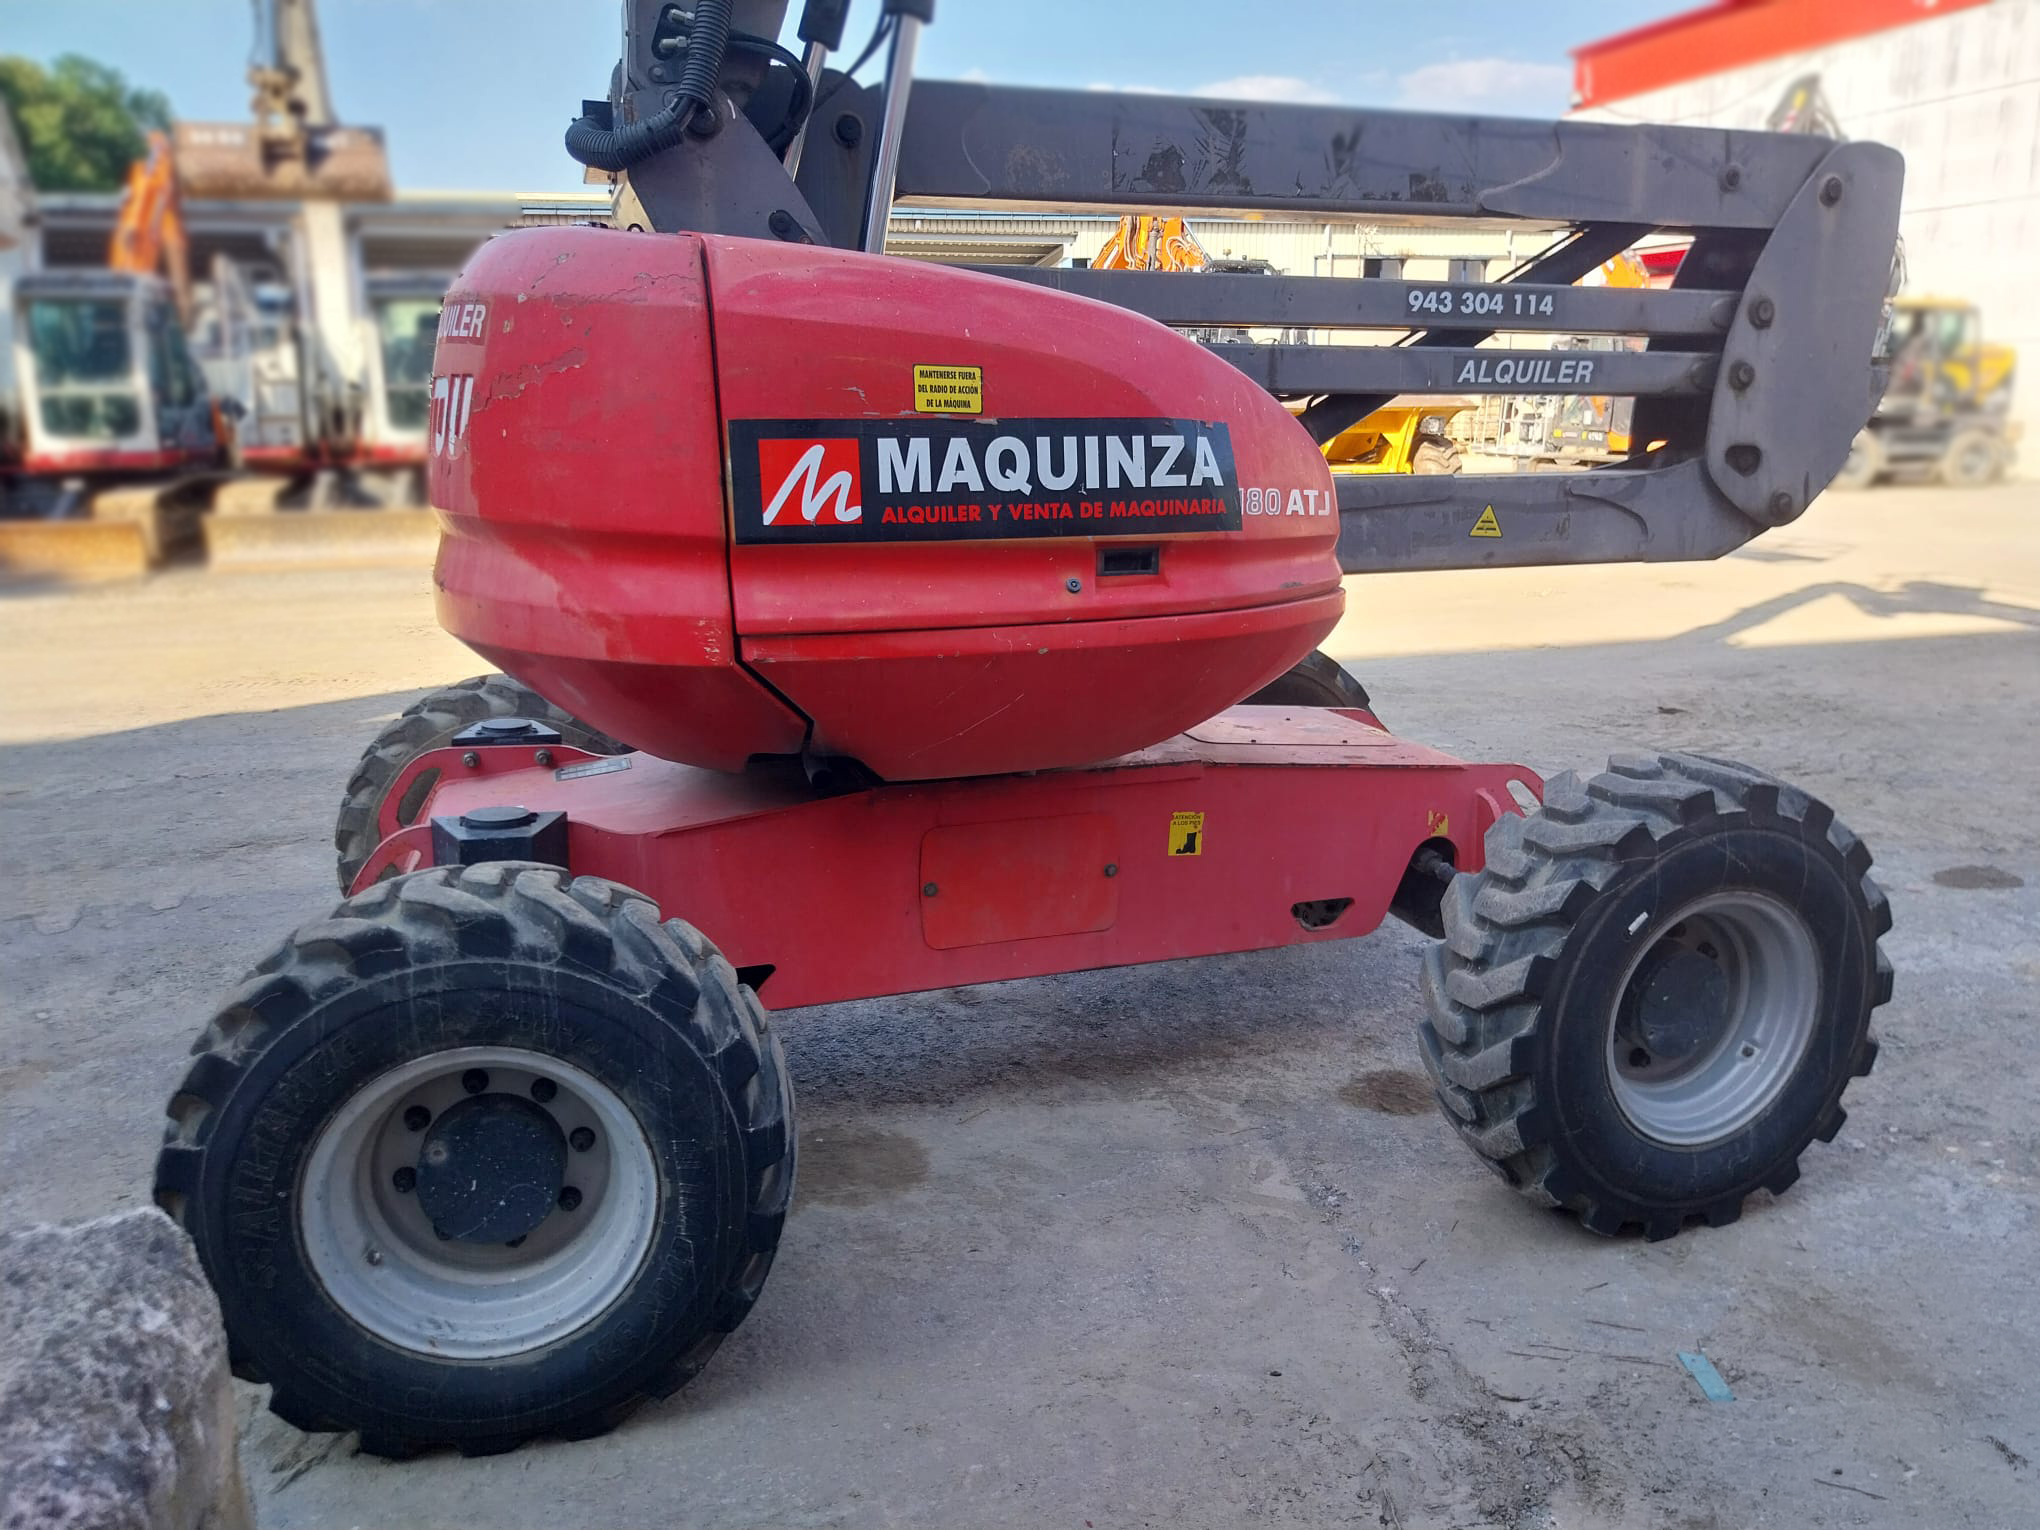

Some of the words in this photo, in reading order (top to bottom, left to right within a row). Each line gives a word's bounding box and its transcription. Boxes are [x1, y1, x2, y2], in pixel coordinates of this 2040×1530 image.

[1408, 290, 1452, 314] 943
[1460, 292, 1503, 315] 304
[1514, 294, 1553, 316] 114
[919, 369, 957, 380] MANTENERSE
[958, 371, 976, 380] FUERA
[1457, 359, 1594, 384] ALQUILER
[918, 384, 928, 393] DEL
[930, 385, 948, 394] RADIO
[949, 385, 957, 394] DE
[958, 384, 979, 395] ACCIÓN
[926, 399, 934, 408] DE
[935, 399, 942, 408] LA
[944, 397, 971, 409] MÁQUINA
[877, 435, 1224, 496] MAQUINZA
[882, 504, 981, 524] ALQUILER
[988, 504, 1002, 521] Y
[1008, 501, 1073, 521] VENTA
[1080, 501, 1103, 519] DE
[1110, 498, 1227, 518] MAQUINARIA
[1286, 488, 1331, 516] ATJ
